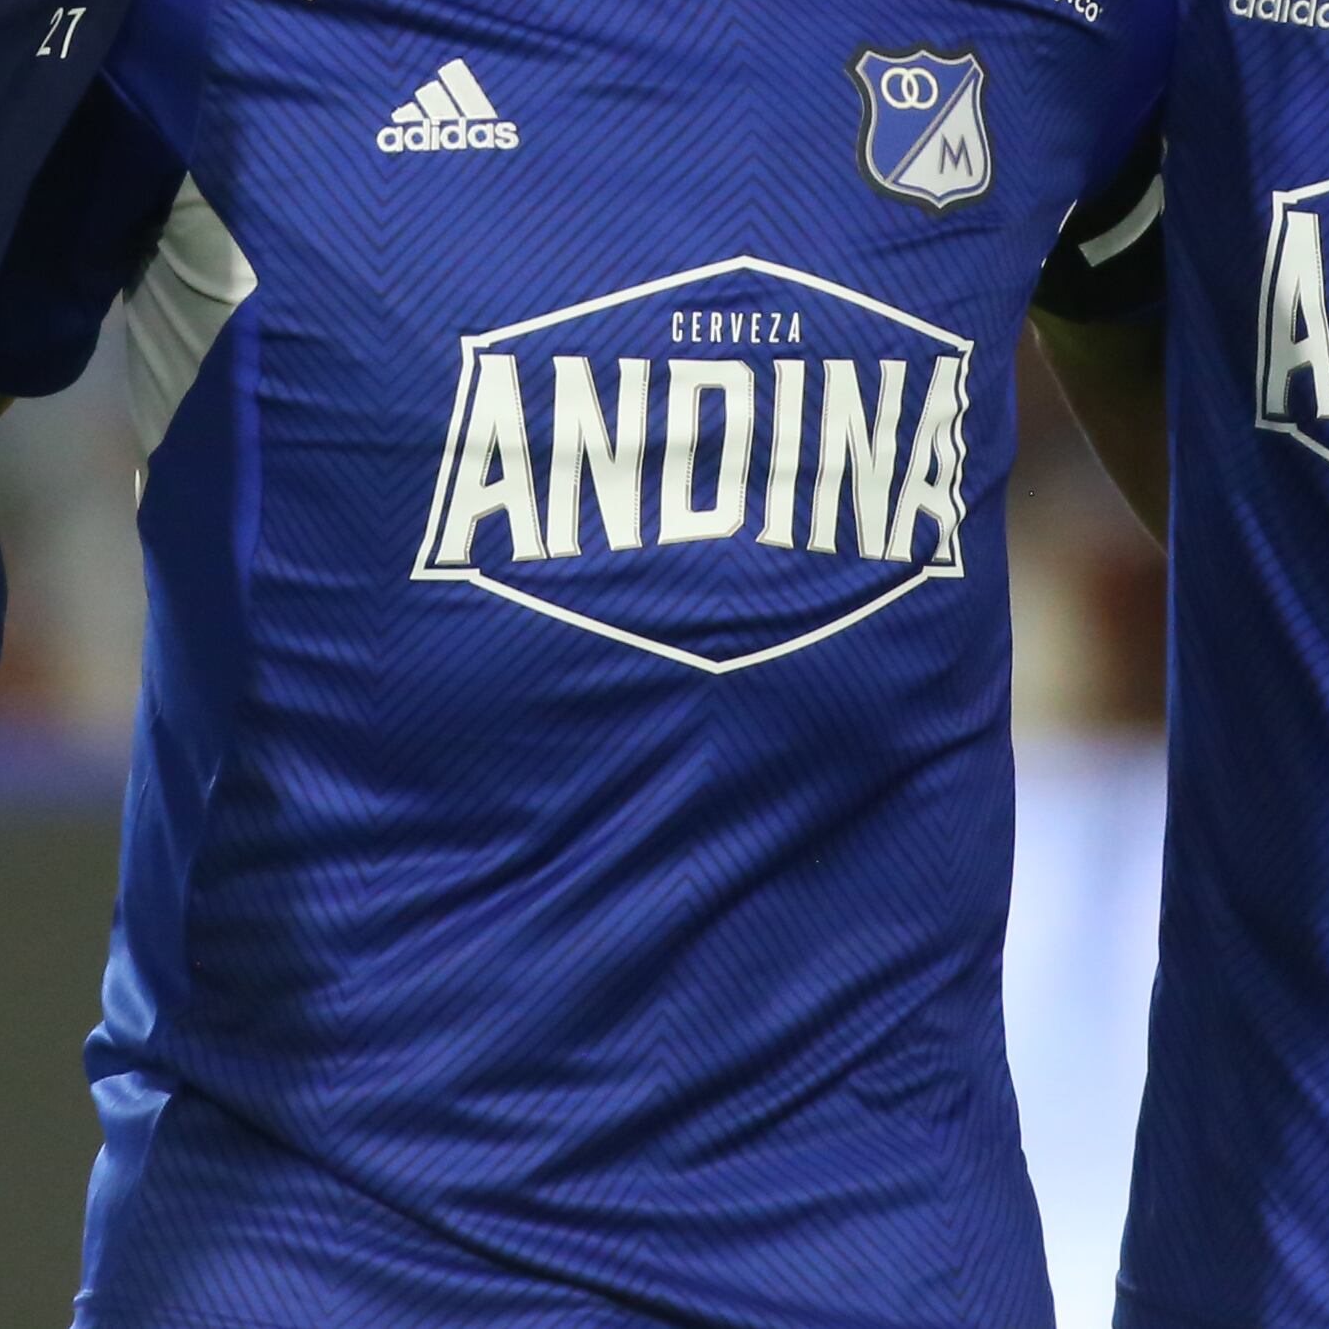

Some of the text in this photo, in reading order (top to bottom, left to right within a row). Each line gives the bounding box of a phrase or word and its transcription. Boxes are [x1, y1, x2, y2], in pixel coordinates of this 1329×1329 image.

[36, 7, 87, 59] 27
[376, 120, 520, 153] adidas
[938, 133, 974, 178] M
[671, 310, 803, 344] CERVEZA
[434, 353, 964, 566] ANDINA
